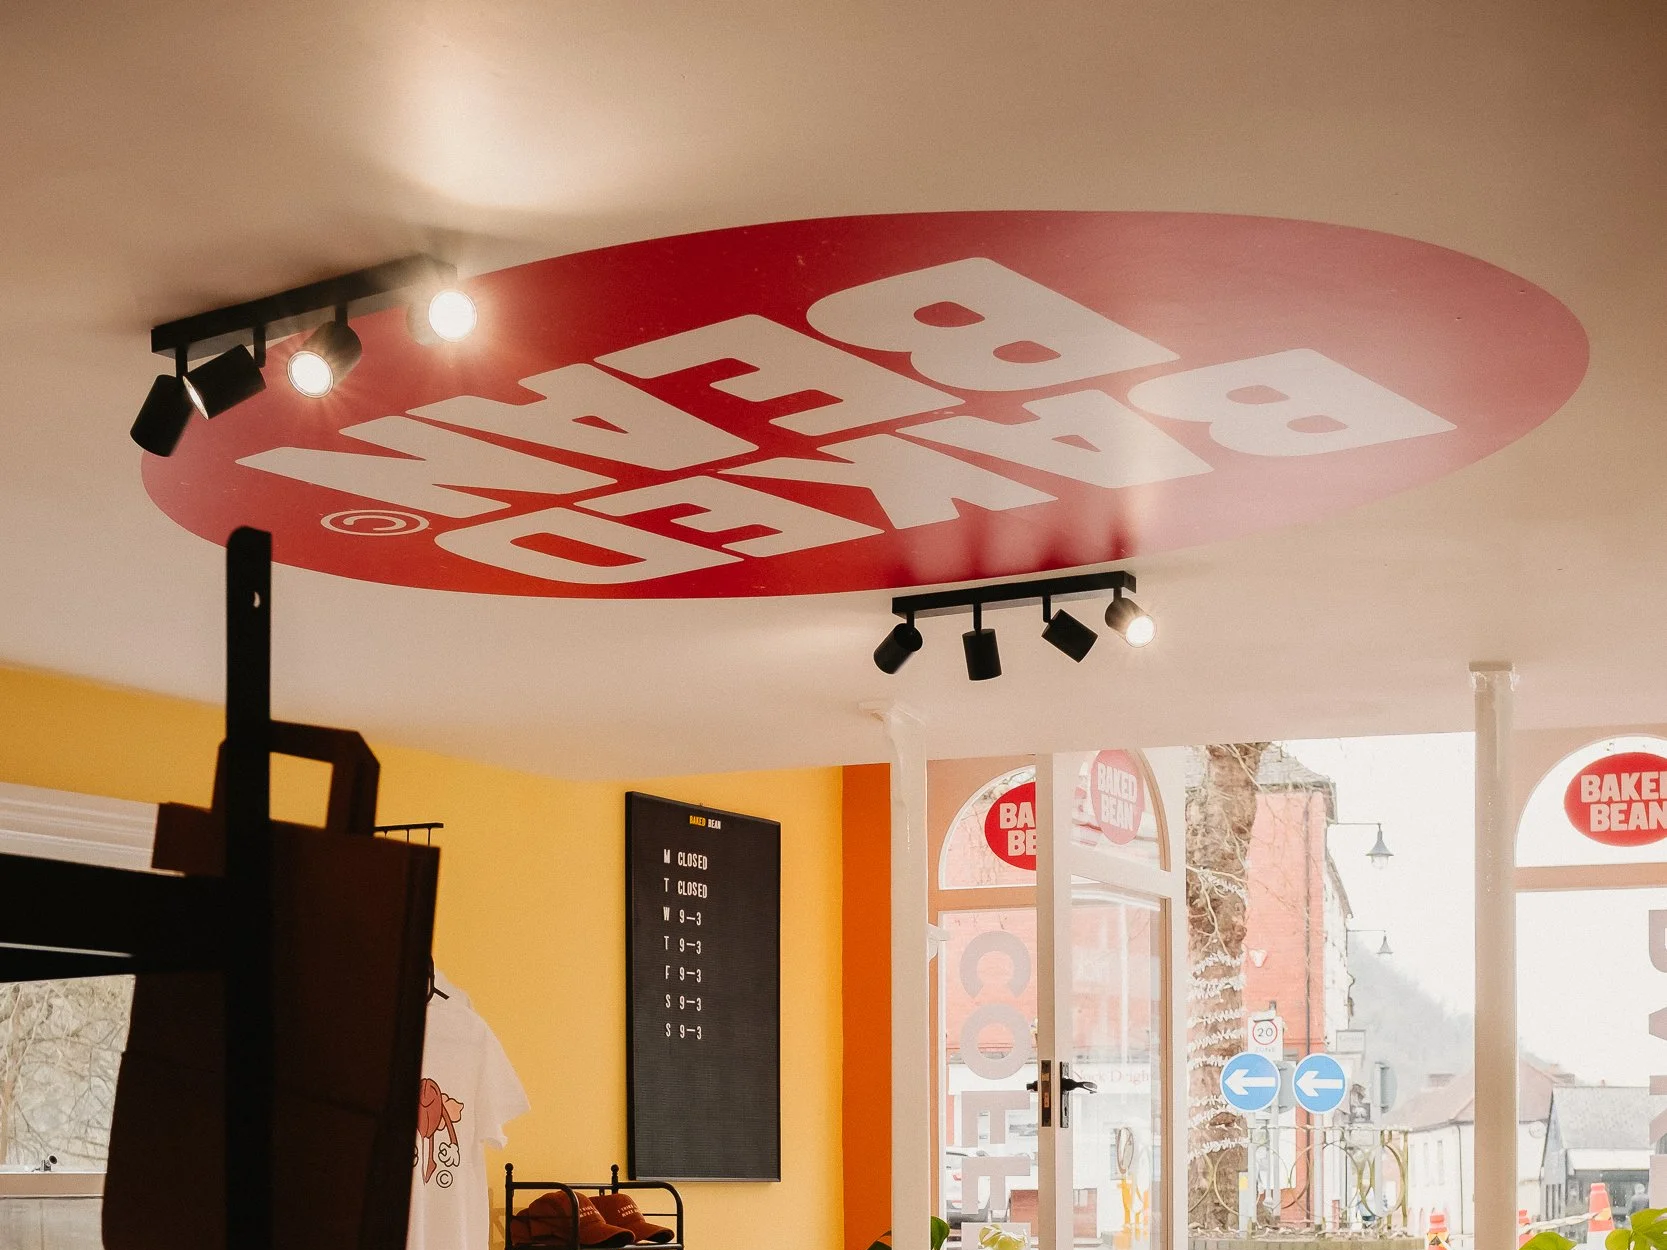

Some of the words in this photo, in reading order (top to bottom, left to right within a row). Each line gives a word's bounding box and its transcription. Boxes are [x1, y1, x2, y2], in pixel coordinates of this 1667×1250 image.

[235, 257, 1181, 518] BEAN
[434, 348, 1458, 584] BAKED
[1097, 762, 1137, 804] BAKED
[689, 815, 707, 827] BAKED
[707, 818, 722, 830] BEAN
[1101, 794, 1134, 831] BEAN
[1590, 801, 1667, 832] BEAN
[1008, 830, 1037, 857] BE
[663, 849, 671, 864] M
[677, 851, 708, 870] CLOSED
[663, 877, 670, 893] T
[677, 880, 708, 899] CLOSED
[663, 906, 670, 921] W
[663, 935, 670, 950] T
[665, 965, 671, 980] F
[665, 994, 671, 1008] S
[665, 1022, 671, 1037] S
[1257, 1027, 1274, 1037] 20
